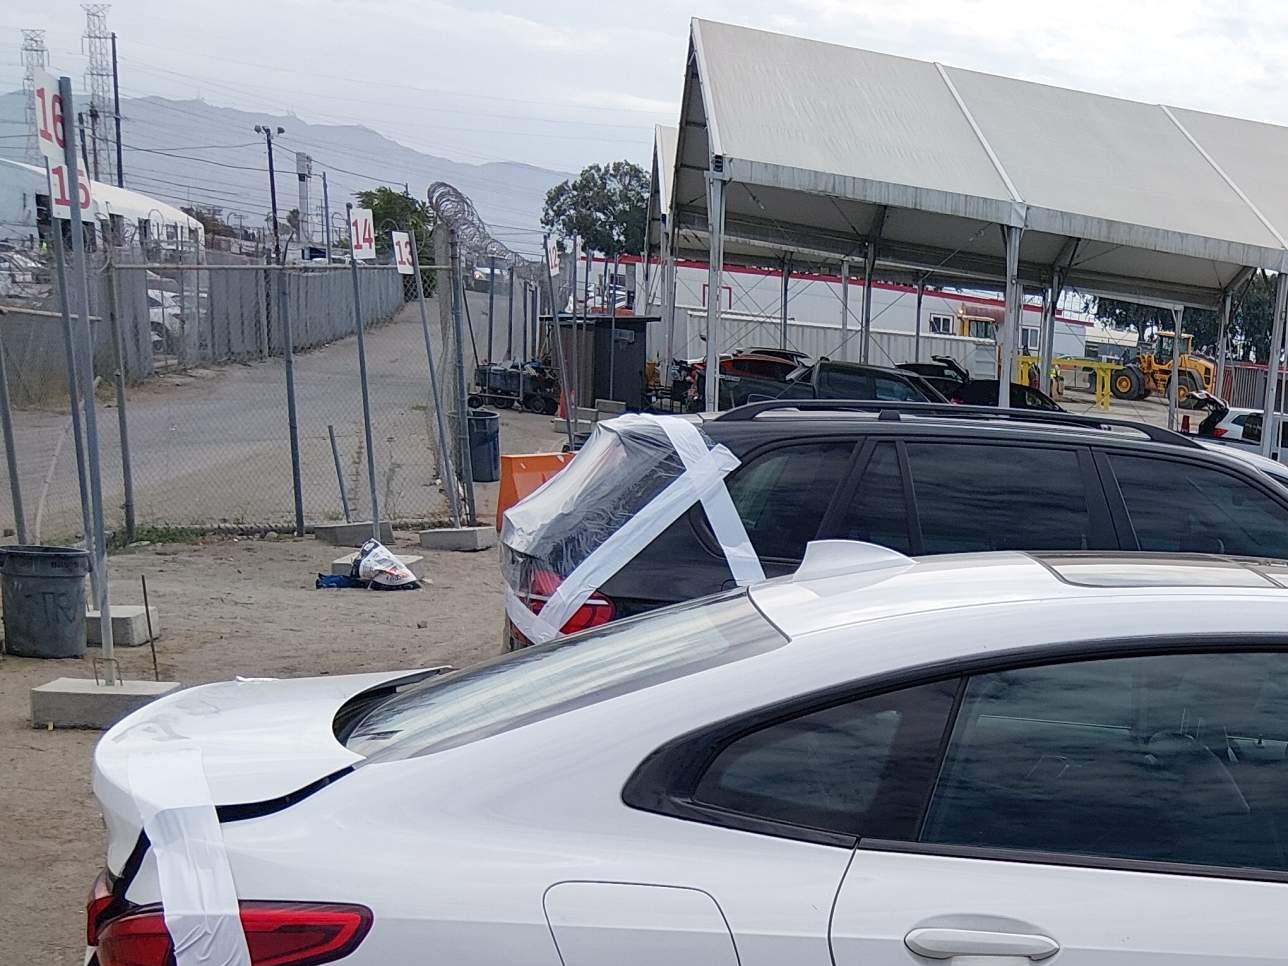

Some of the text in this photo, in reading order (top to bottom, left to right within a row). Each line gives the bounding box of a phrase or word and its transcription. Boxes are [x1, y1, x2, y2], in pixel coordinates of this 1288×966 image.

[52, 165, 91, 209] 15
[352, 218, 374, 250] 14
[395, 240, 414, 267] 13
